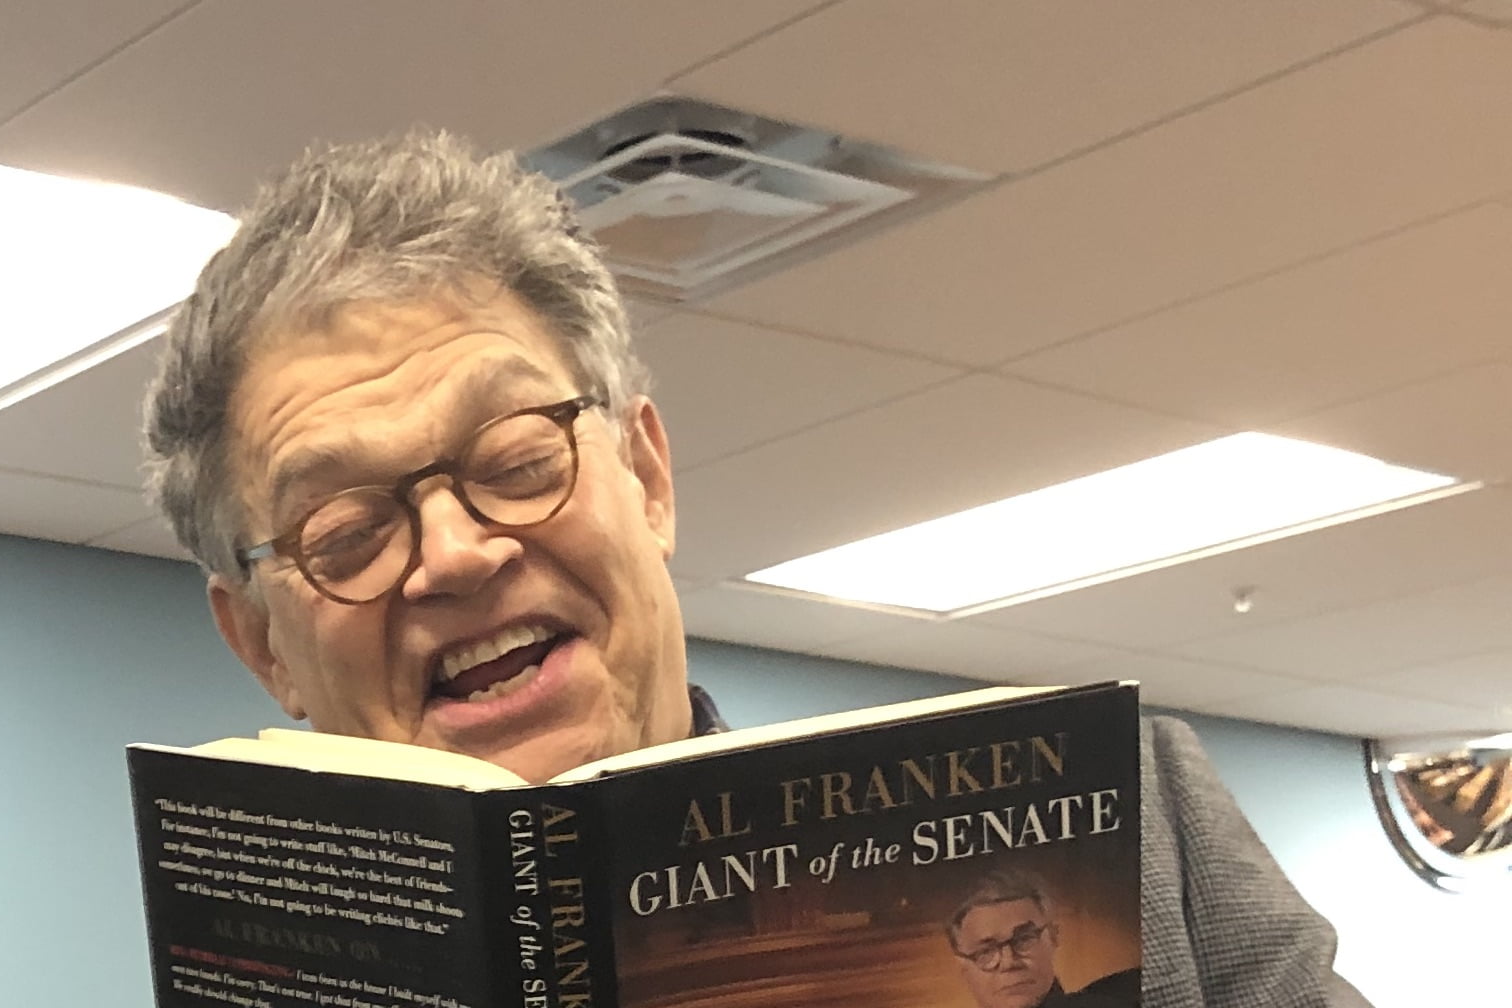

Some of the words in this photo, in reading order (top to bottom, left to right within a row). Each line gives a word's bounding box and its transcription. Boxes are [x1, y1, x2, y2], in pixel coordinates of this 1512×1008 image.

[678, 792, 752, 847] AL
[780, 733, 1071, 827] FRANKEN
[378, 828, 391, 844] by
[508, 809, 538, 896] GIANT
[541, 803, 578, 857] AL
[629, 844, 799, 917] GIANT
[809, 843, 843, 884] of
[851, 838, 901, 869] the
[912, 788, 1121, 866] SENATE
[509, 905, 541, 931] of
[518, 935, 543, 971] the
